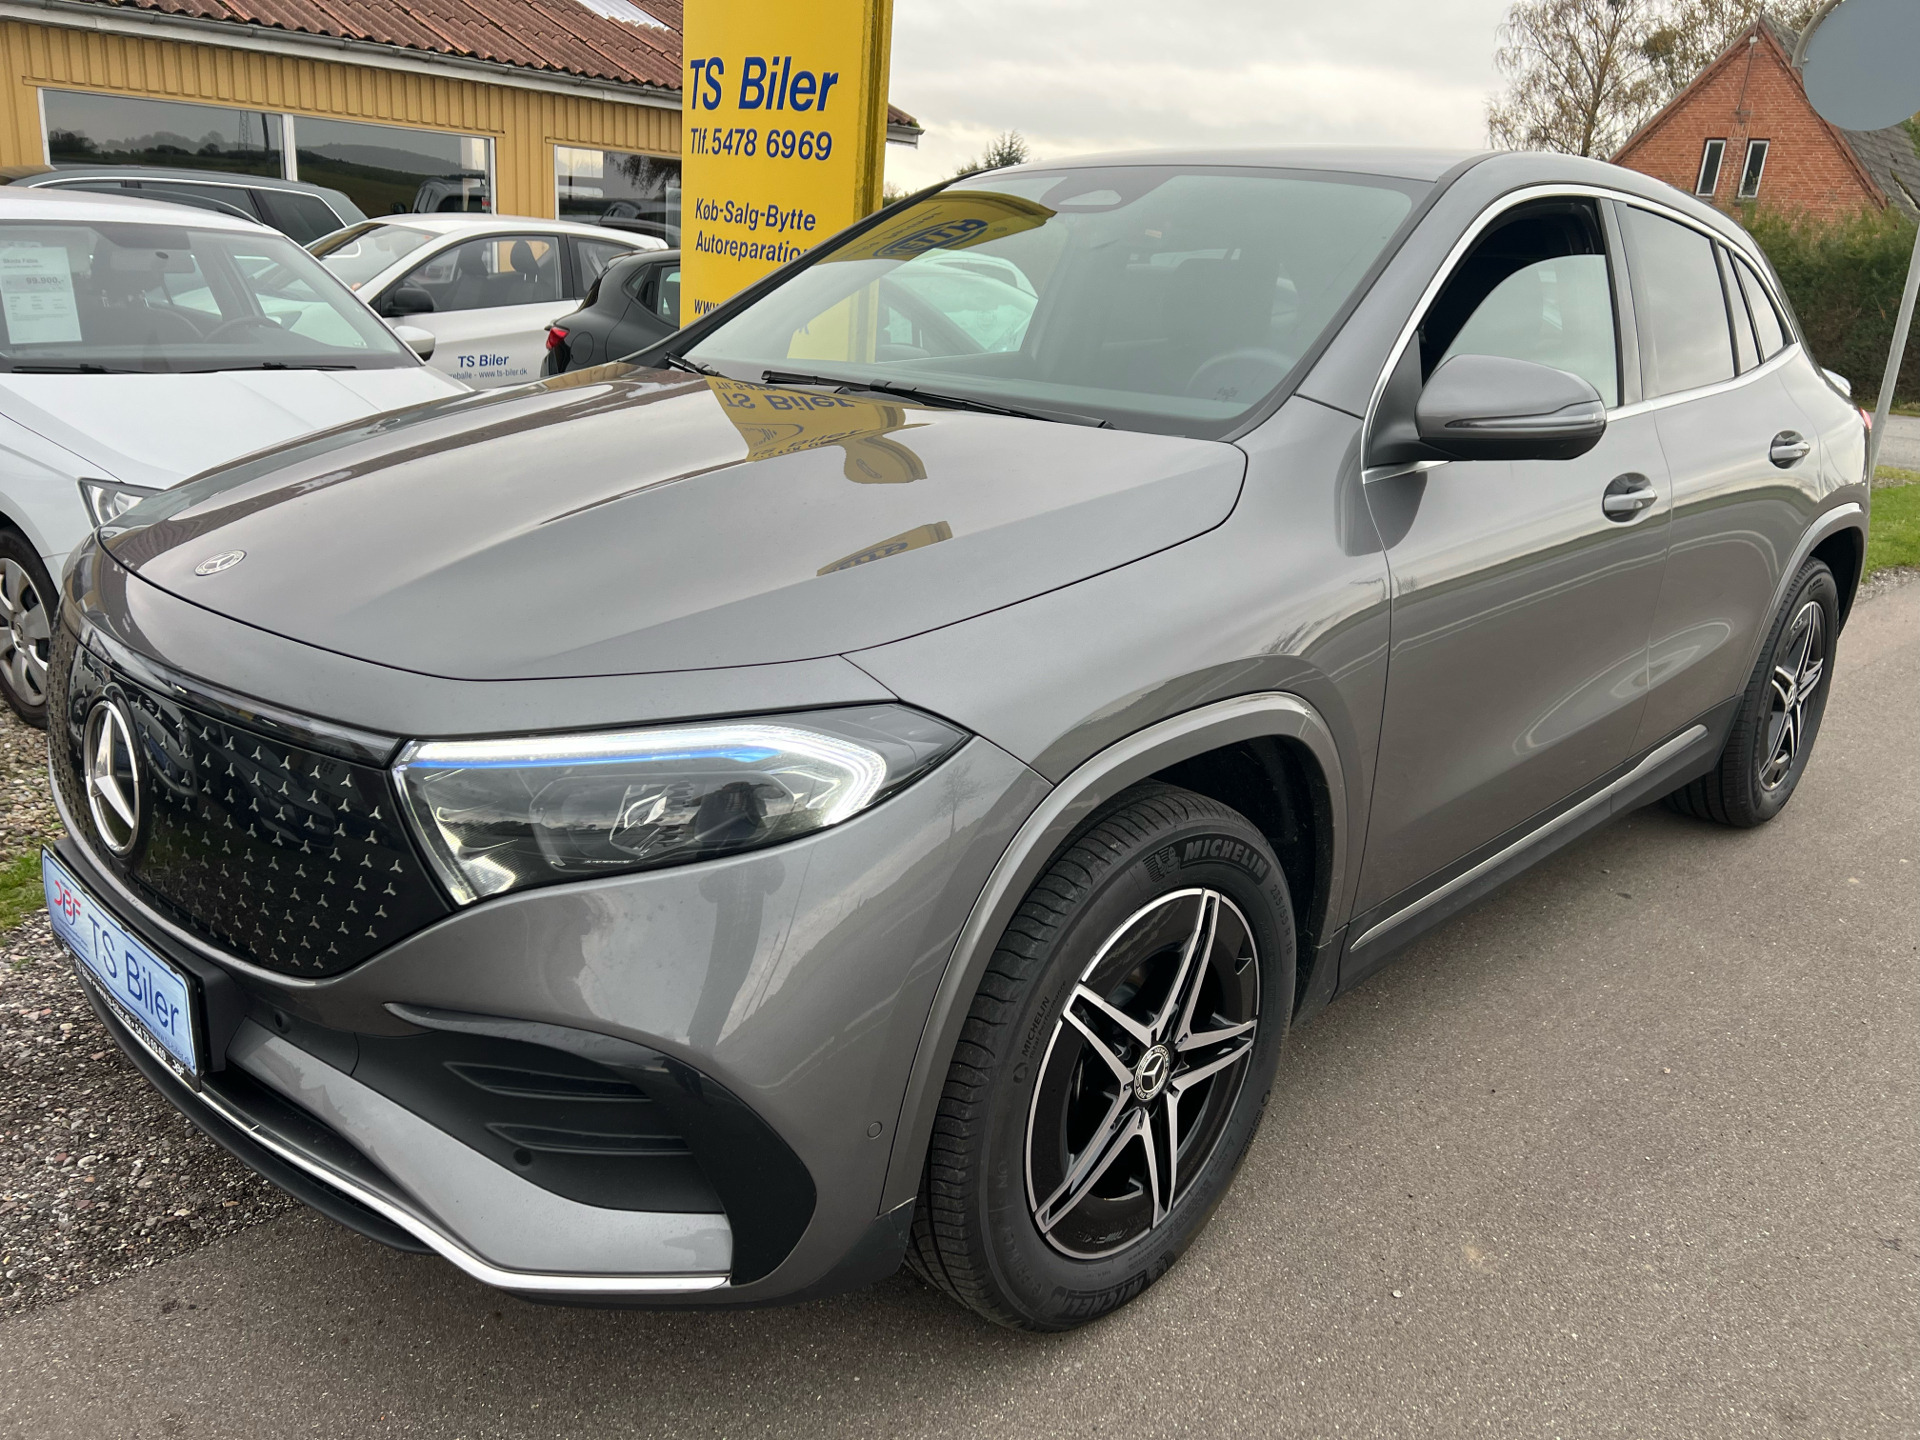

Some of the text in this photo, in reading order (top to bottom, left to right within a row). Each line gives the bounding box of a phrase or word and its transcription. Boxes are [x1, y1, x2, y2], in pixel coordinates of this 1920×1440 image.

[690, 56, 839, 112] TS Biler
[766, 129, 833, 161] 6969
[695, 197, 816, 233] Køb-Salg-Bytte
[458, 354, 510, 368] TS Biler
[1183, 839, 1268, 878] MICHELIN
[88, 913, 117, 978] TS
[125, 950, 179, 1036] Biler
[1022, 996, 1049, 1057] MICHELIN
